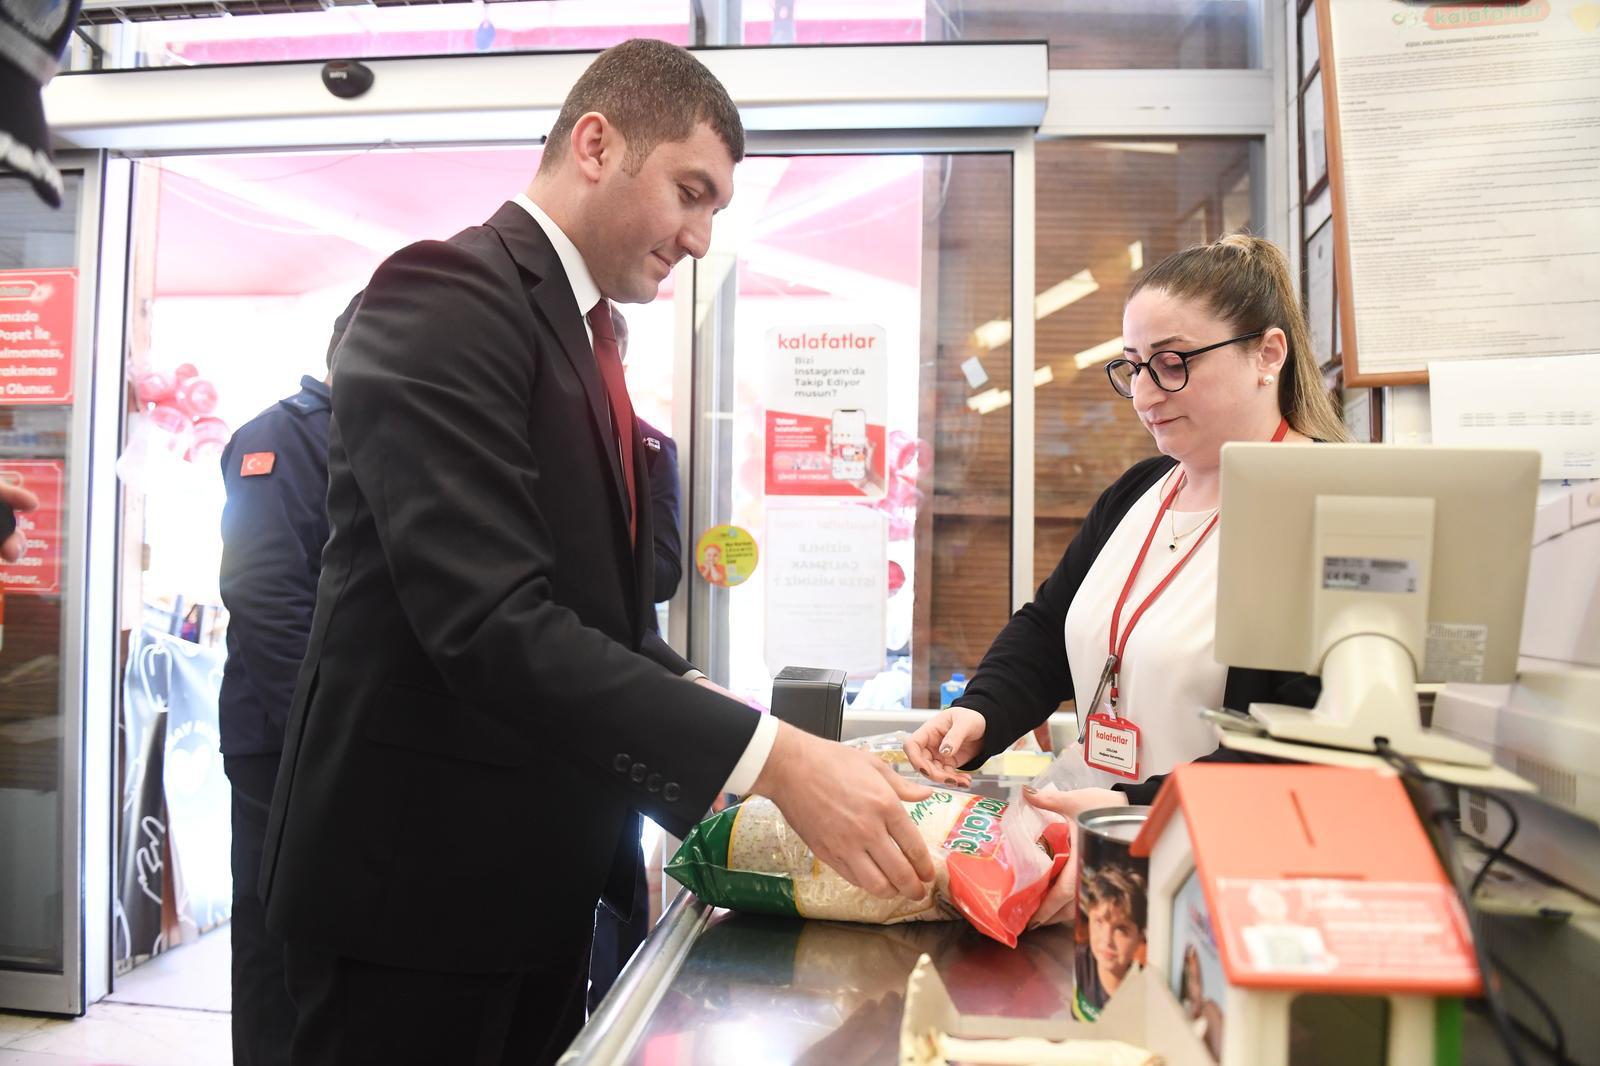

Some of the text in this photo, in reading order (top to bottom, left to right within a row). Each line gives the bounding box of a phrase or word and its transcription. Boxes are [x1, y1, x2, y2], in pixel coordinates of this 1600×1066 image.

[778, 333, 876, 349] kalafatlar
[795, 378, 861, 388] Takip Ediyor
[1096, 730, 1128, 745] kalafatlar
